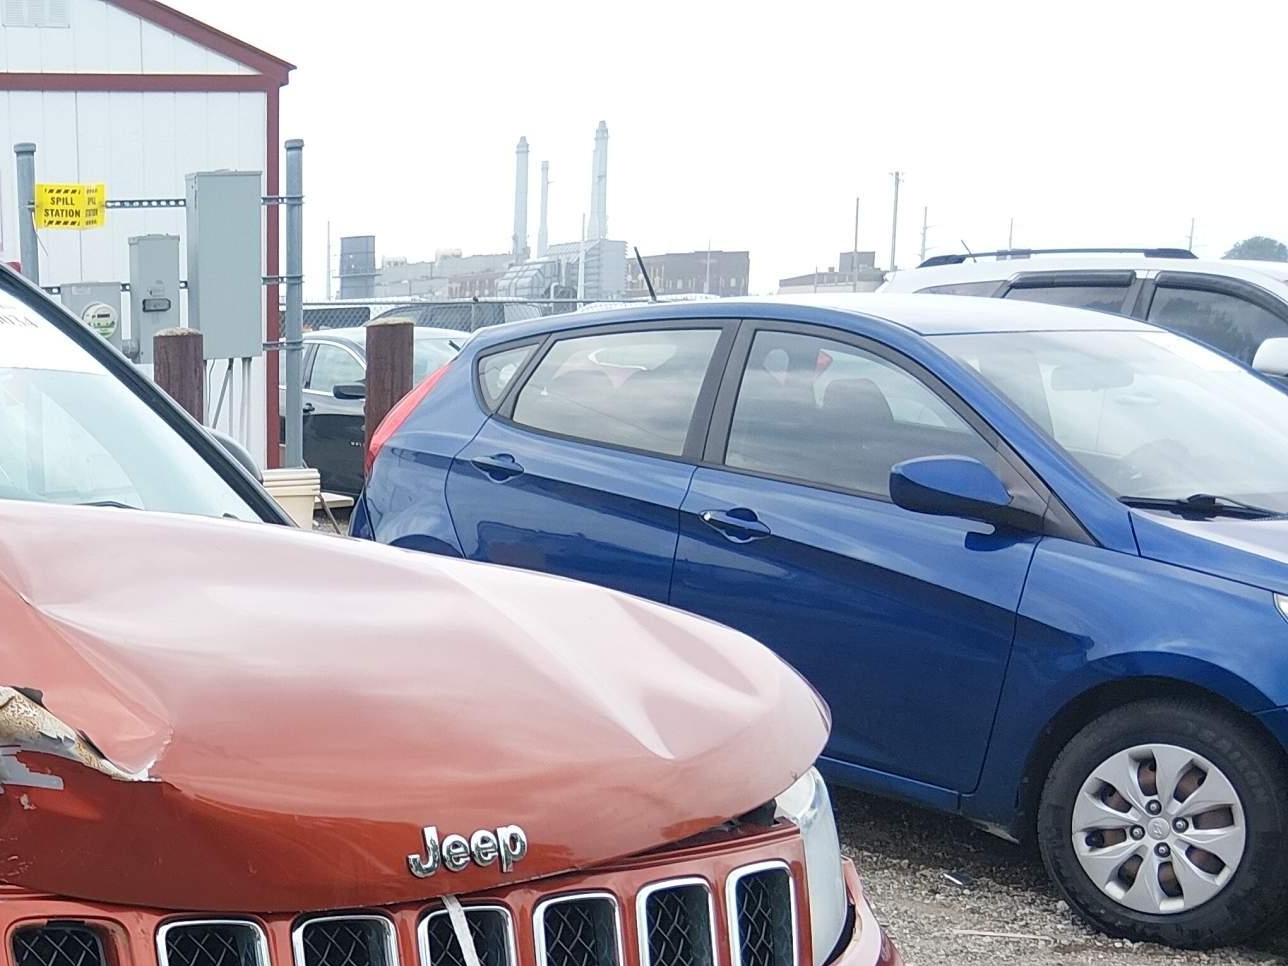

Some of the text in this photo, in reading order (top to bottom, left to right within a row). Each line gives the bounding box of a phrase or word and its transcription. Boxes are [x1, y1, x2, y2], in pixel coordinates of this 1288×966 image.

[50, 196, 76, 206] SPILL
[43, 208, 81, 218] STATION
[407, 824, 528, 879] Jeep
